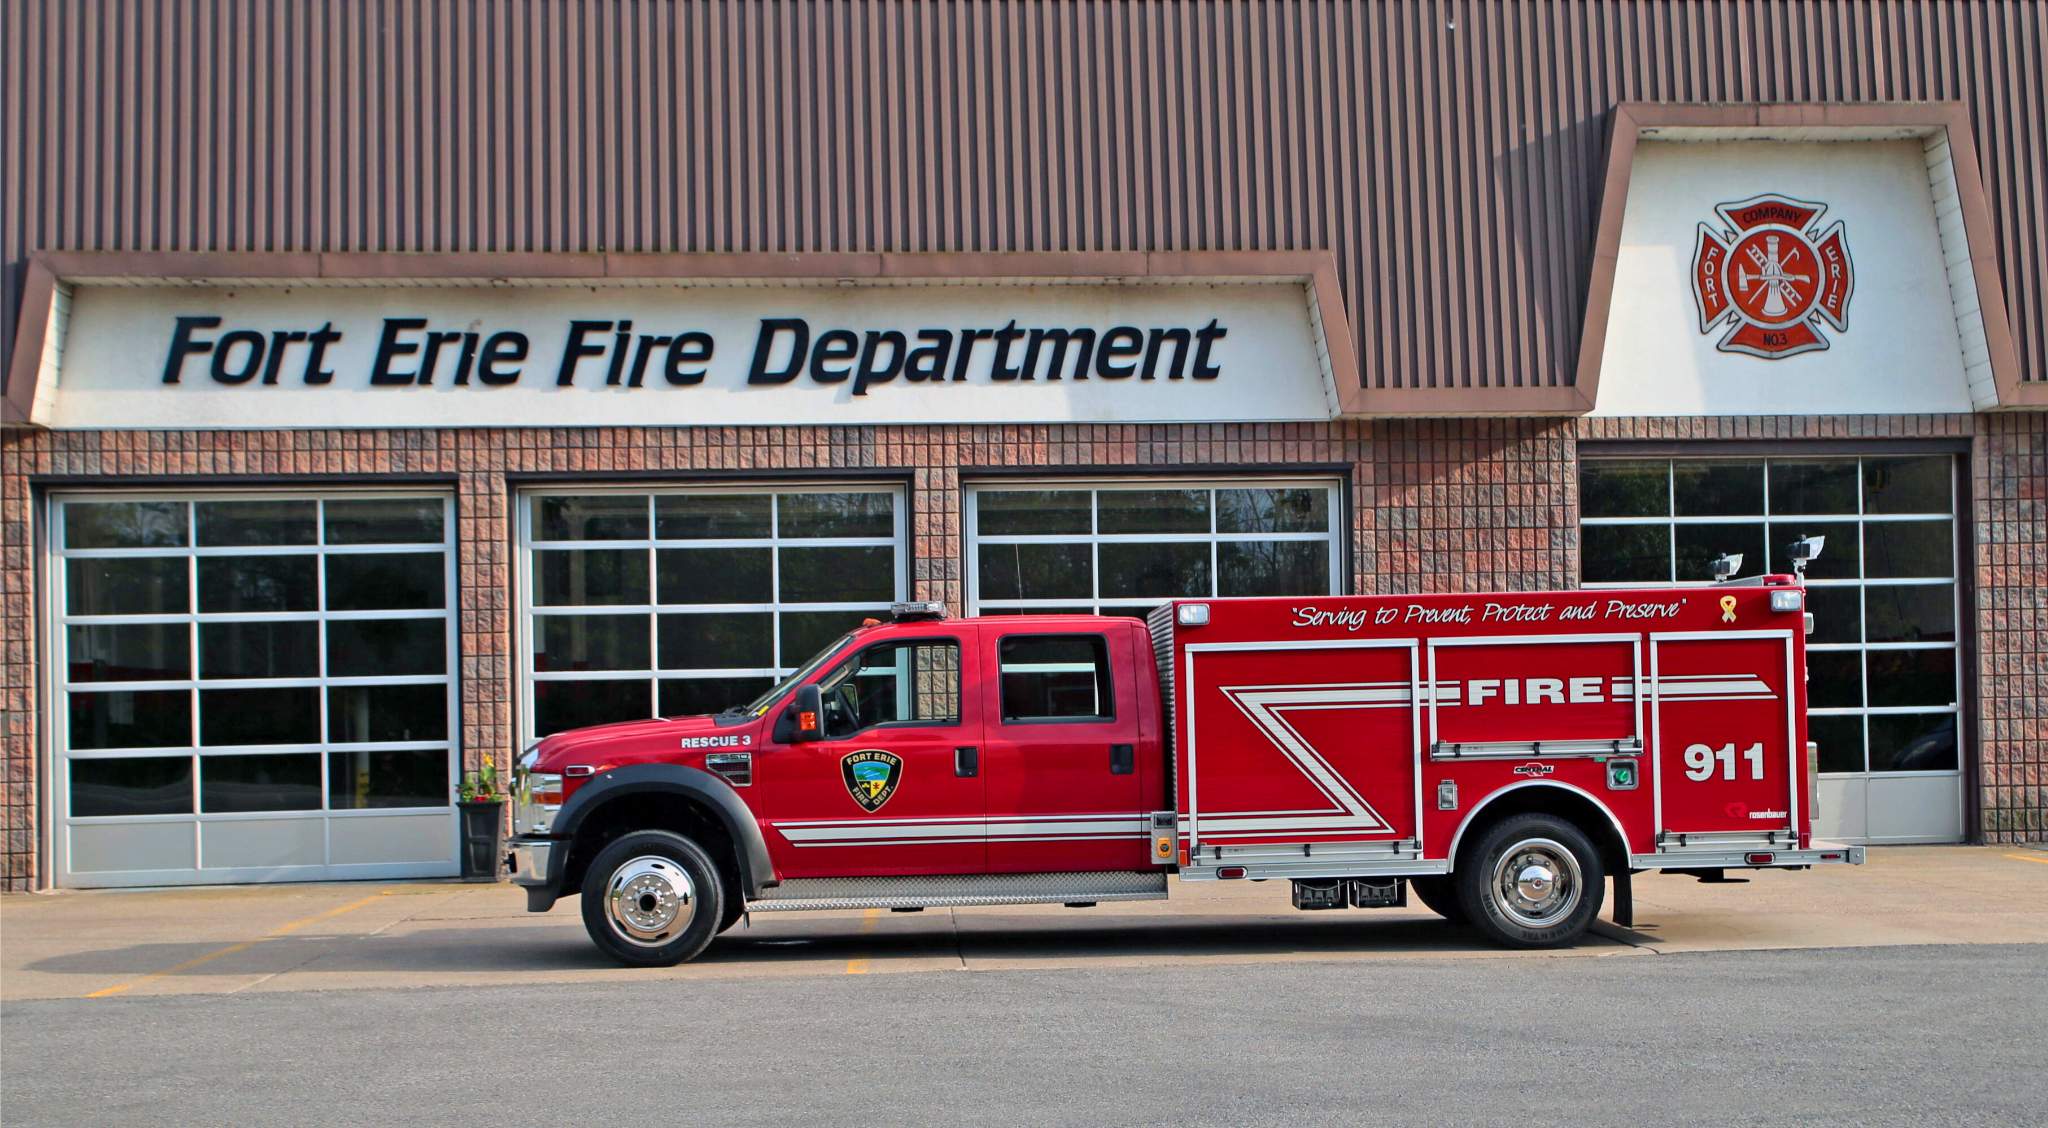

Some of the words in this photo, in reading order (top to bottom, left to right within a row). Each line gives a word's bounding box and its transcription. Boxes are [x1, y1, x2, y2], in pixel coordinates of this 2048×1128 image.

[1742, 207, 1801, 223] COMPANY
[1704, 246, 1719, 308] FORT
[1825, 245, 1841, 309] ERIE
[162, 316, 342, 385] Fort
[371, 317, 529, 387] Erie
[556, 319, 714, 388] Fire
[747, 317, 1227, 397] Department
[1375, 605, 1398, 624] to
[1404, 603, 1475, 624] Prevent,
[1482, 602, 1554, 622] Protect
[1559, 601, 1597, 620] and
[1468, 677, 1605, 706] FIRE
[681, 736, 739, 748] RESCUE
[742, 735, 751, 745] 3
[846, 752, 872, 765] FORT
[874, 753, 897, 766] ERIE
[1684, 742, 1764, 782] 911
[852, 786, 870, 805] FIRE
